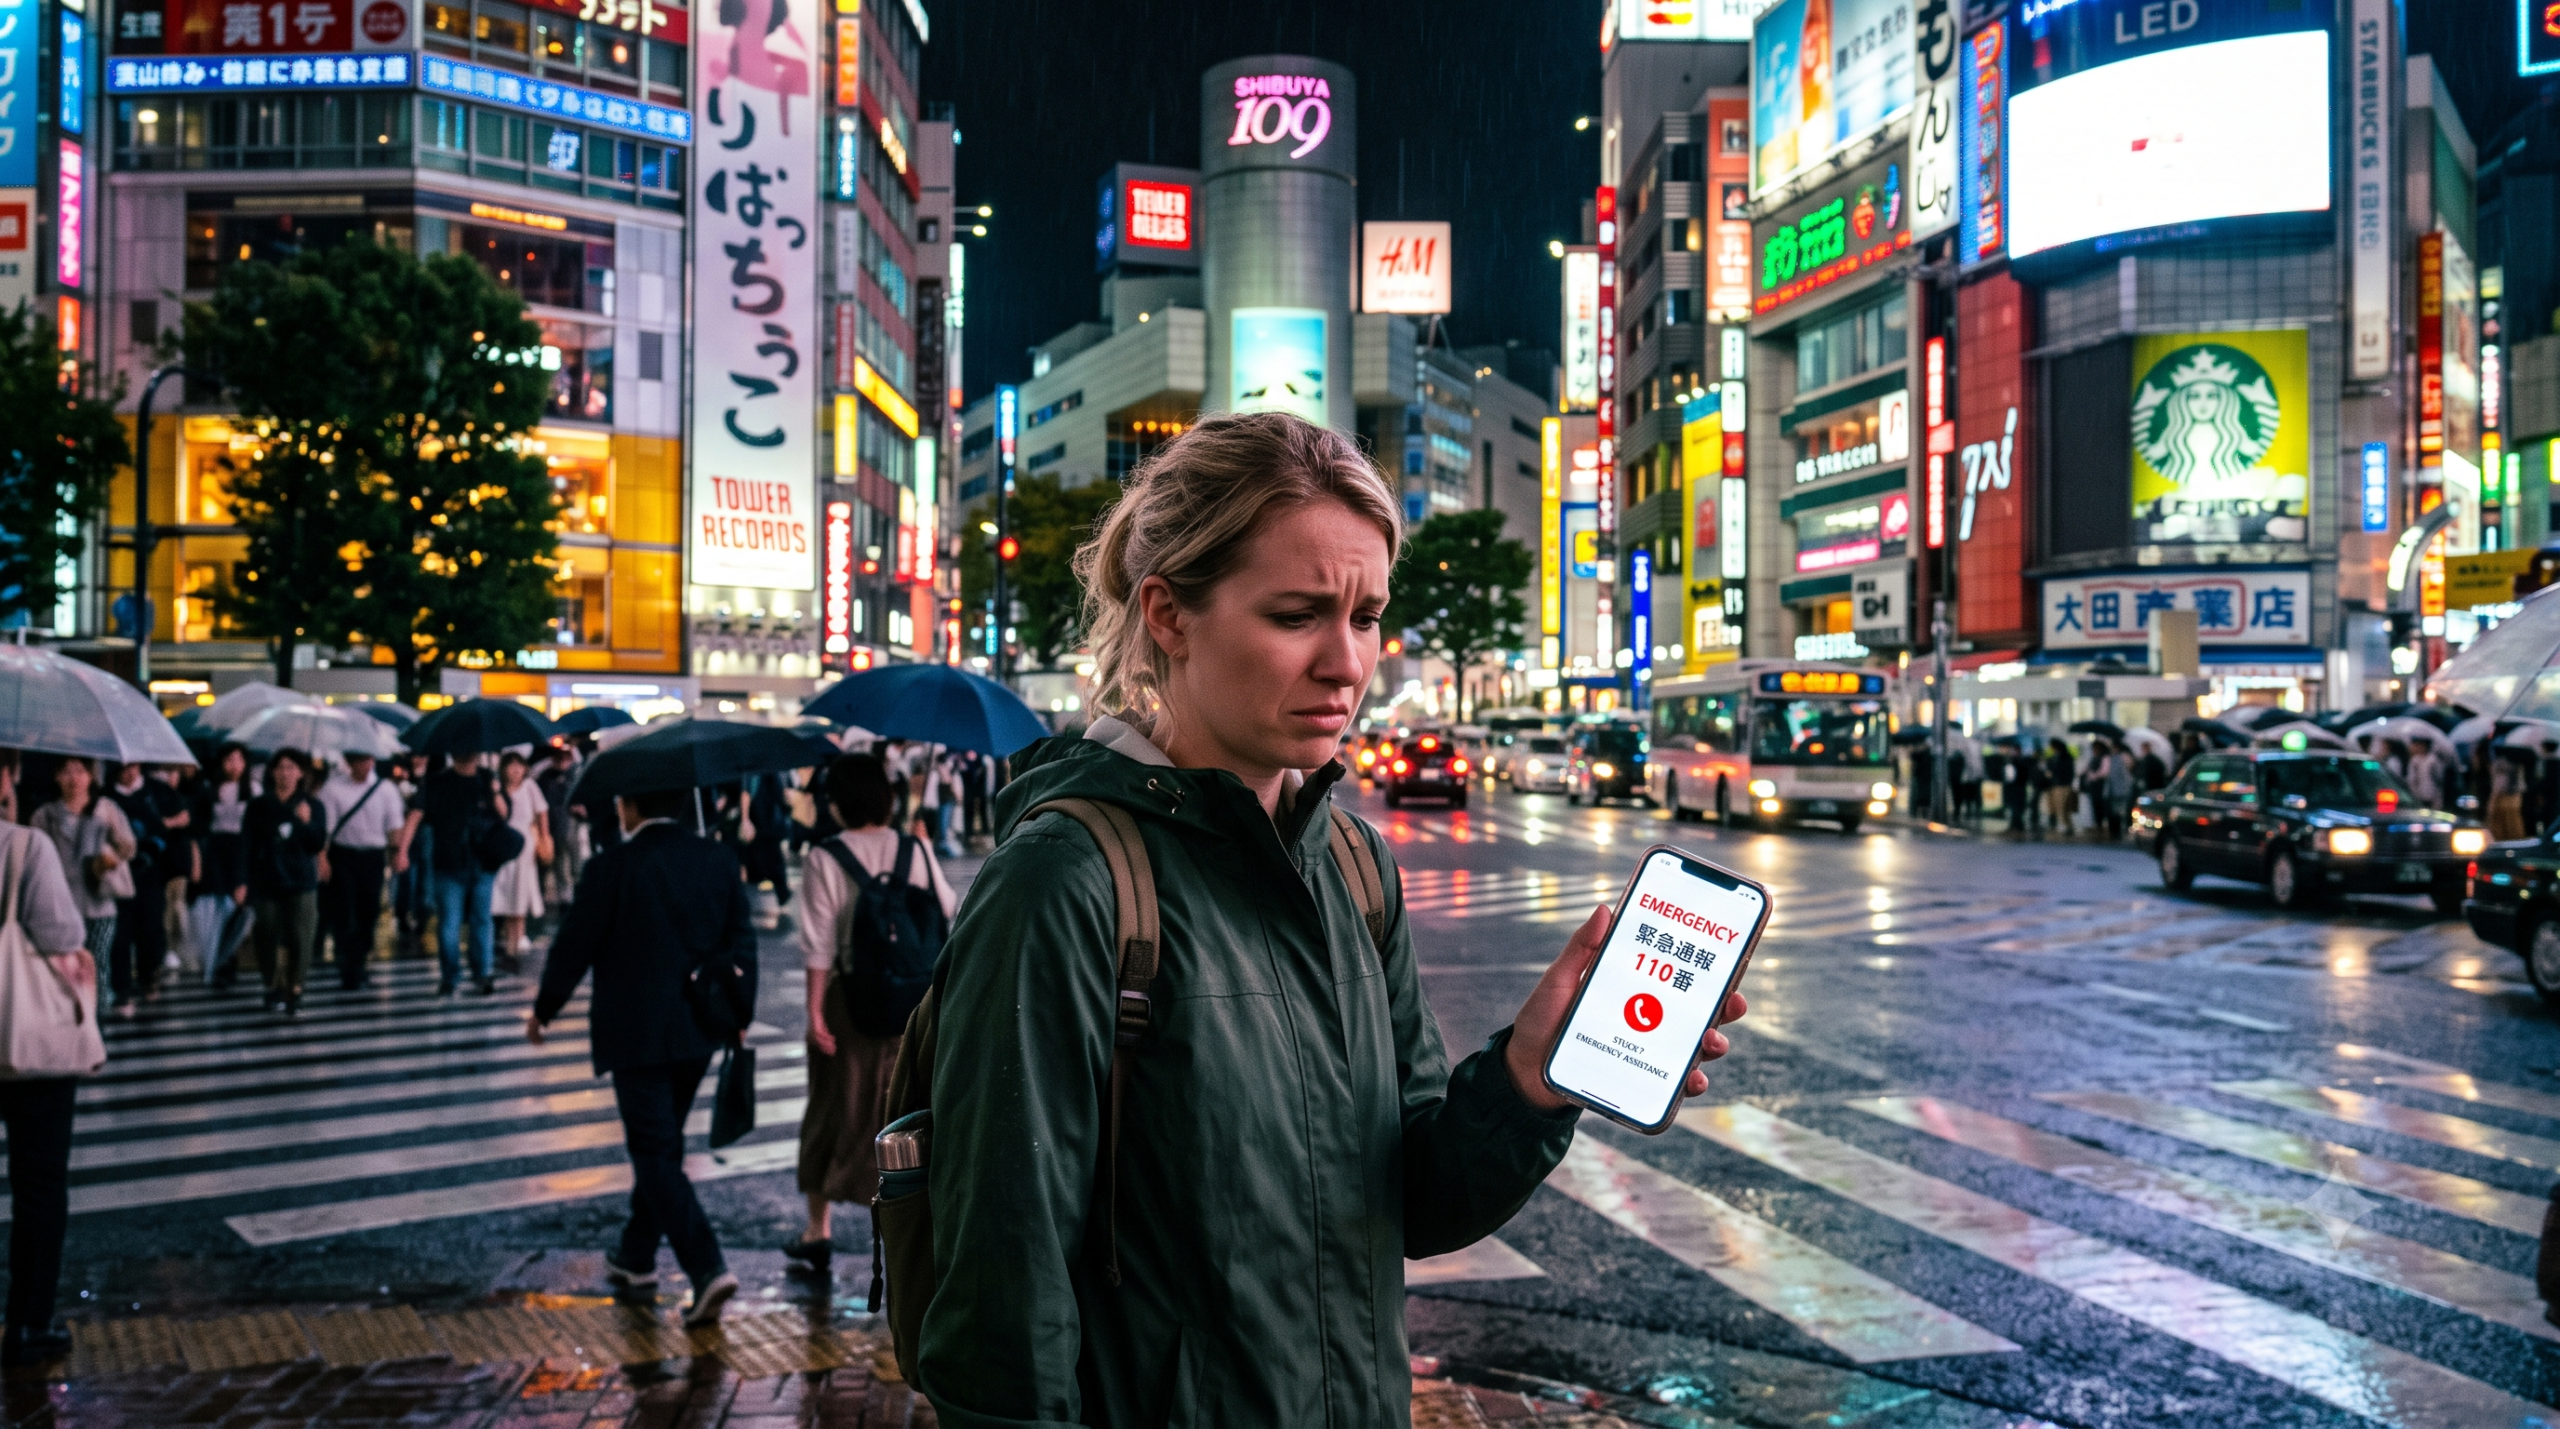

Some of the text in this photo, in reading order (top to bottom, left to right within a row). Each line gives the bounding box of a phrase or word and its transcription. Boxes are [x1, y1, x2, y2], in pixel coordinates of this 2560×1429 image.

[2115, 0, 2199, 44] LED
[1234, 75, 1330, 99] SHIBUYA
[1228, 96, 1332, 160] 109
[711, 475, 792, 515] TOWER
[702, 514, 806, 554] RECORDS
[1639, 893, 1740, 944] EMERGENCY
[1635, 923, 1717, 972] 緊急通報
[1634, 953, 1695, 993] 110番
[1575, 1032, 1623, 1058] EMERGENCY
